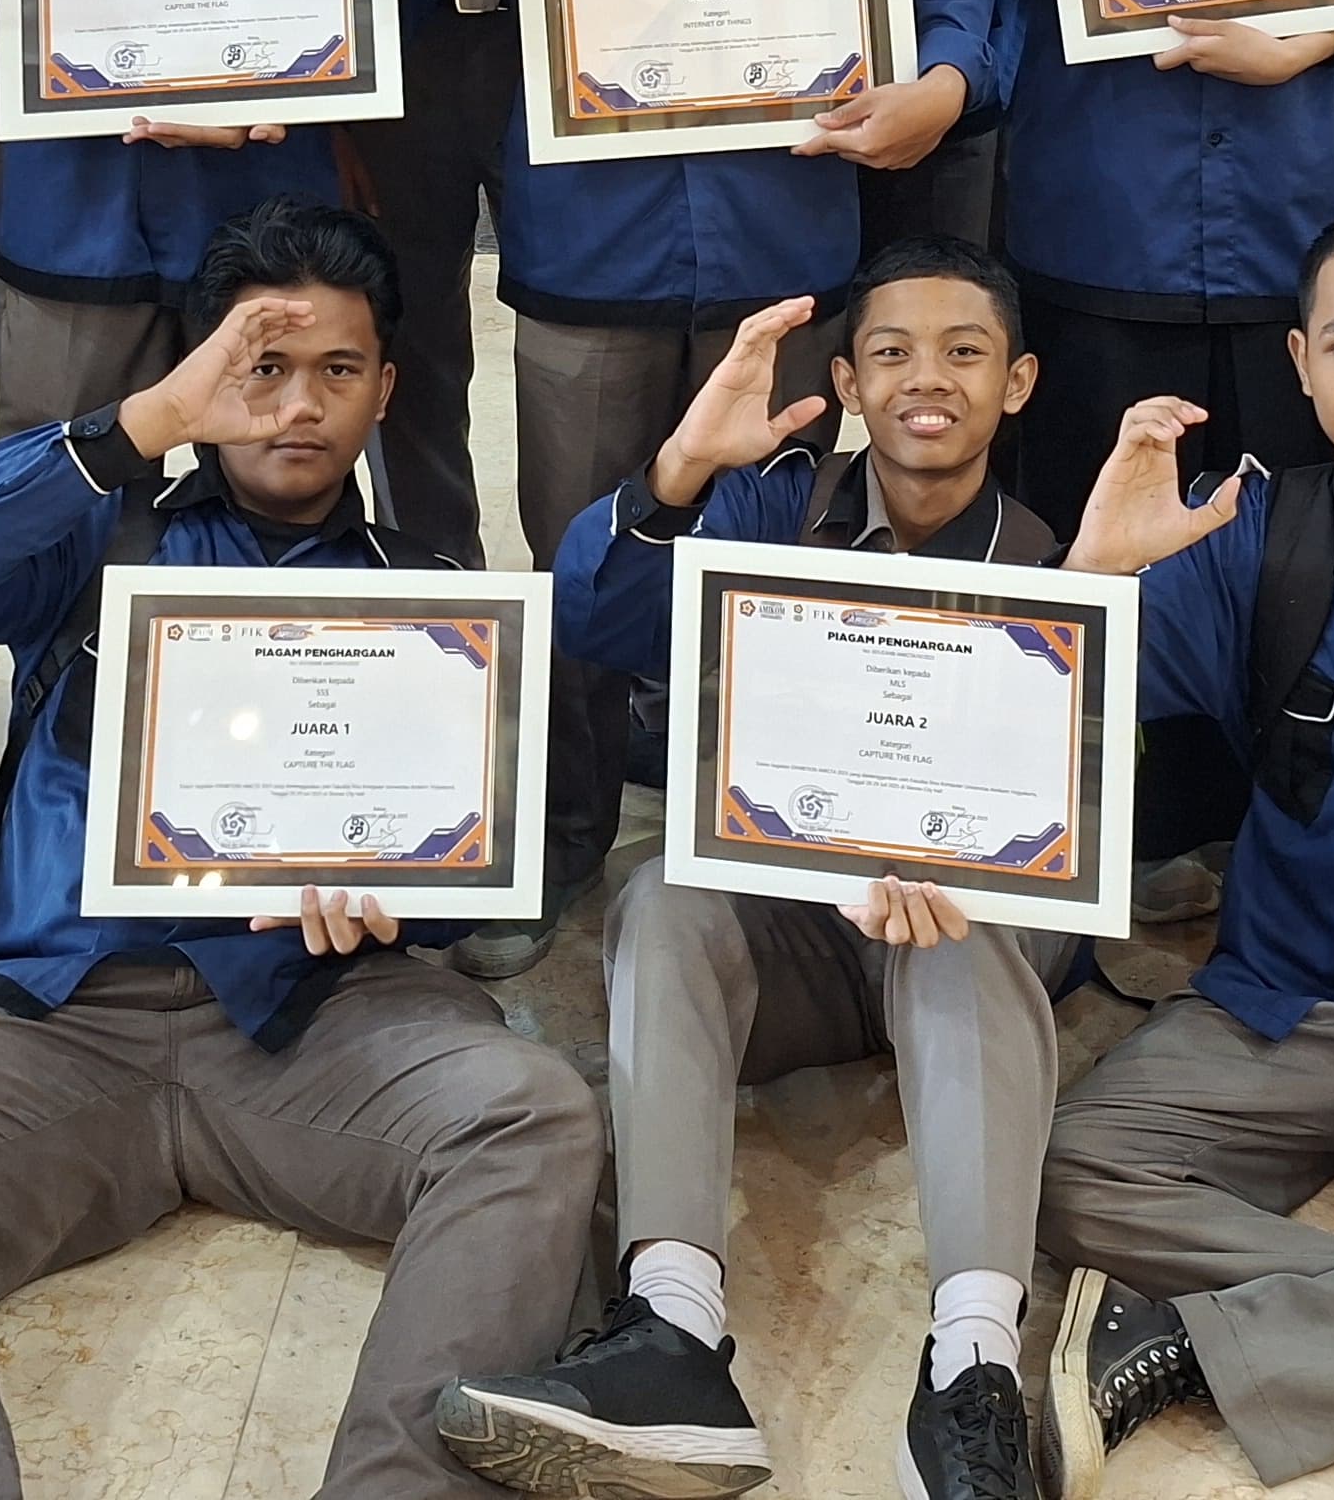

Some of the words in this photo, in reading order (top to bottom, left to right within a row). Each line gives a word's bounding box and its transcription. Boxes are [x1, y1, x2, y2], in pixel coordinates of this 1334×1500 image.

[211, 0, 229, 9] FLAG
[716, 19, 725, 27] OF
[813, 610, 835, 621] FIK
[241, 627, 263, 638] FIK
[827, 630, 875, 645] PIAGAM
[878, 635, 973, 655] PENGHARGAAN
[255, 648, 301, 658] PIAGAM
[304, 648, 395, 658] PENGHARGAAN
[866, 665, 901, 676] Diberikan
[902, 668, 931, 680] kepada
[882, 690, 913, 702] Sebagai
[865, 711, 915, 728] JUARA
[919, 717, 928, 729] 2
[291, 722, 339, 735] JUARA
[343, 722, 351, 735] 1
[859, 749, 894, 761] CAPTURE
[896, 753, 911, 763] THE
[912, 755, 933, 766] FLAG
[283, 760, 318, 770] CAPTURE
[335, 760, 356, 770] FLAG
